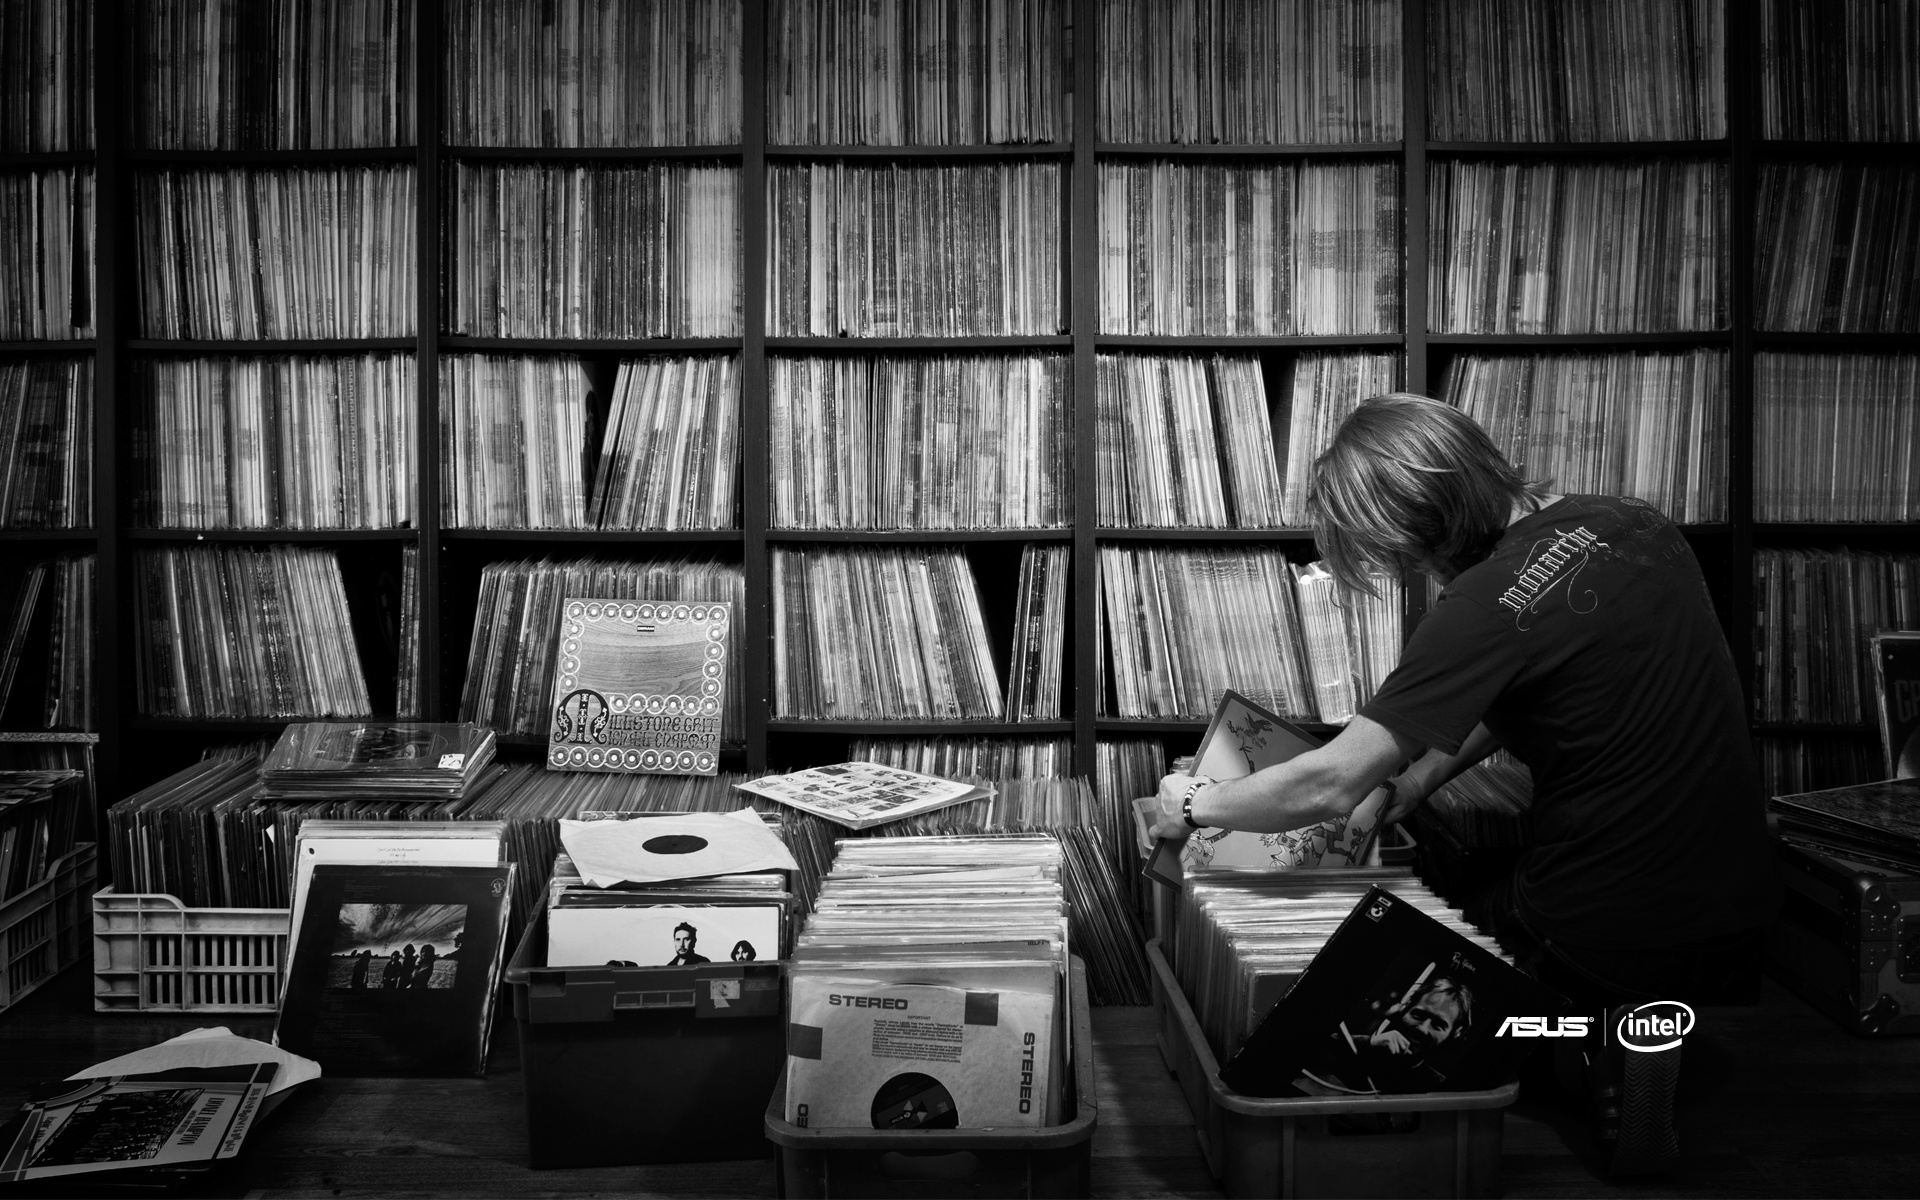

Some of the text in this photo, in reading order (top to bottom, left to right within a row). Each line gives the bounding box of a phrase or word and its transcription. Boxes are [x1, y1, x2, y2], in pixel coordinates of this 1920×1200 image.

[829, 994, 908, 1010] STEREO
[1019, 1031, 1035, 1115] STEREO
[177, 1116, 212, 1146] HAMPTON
